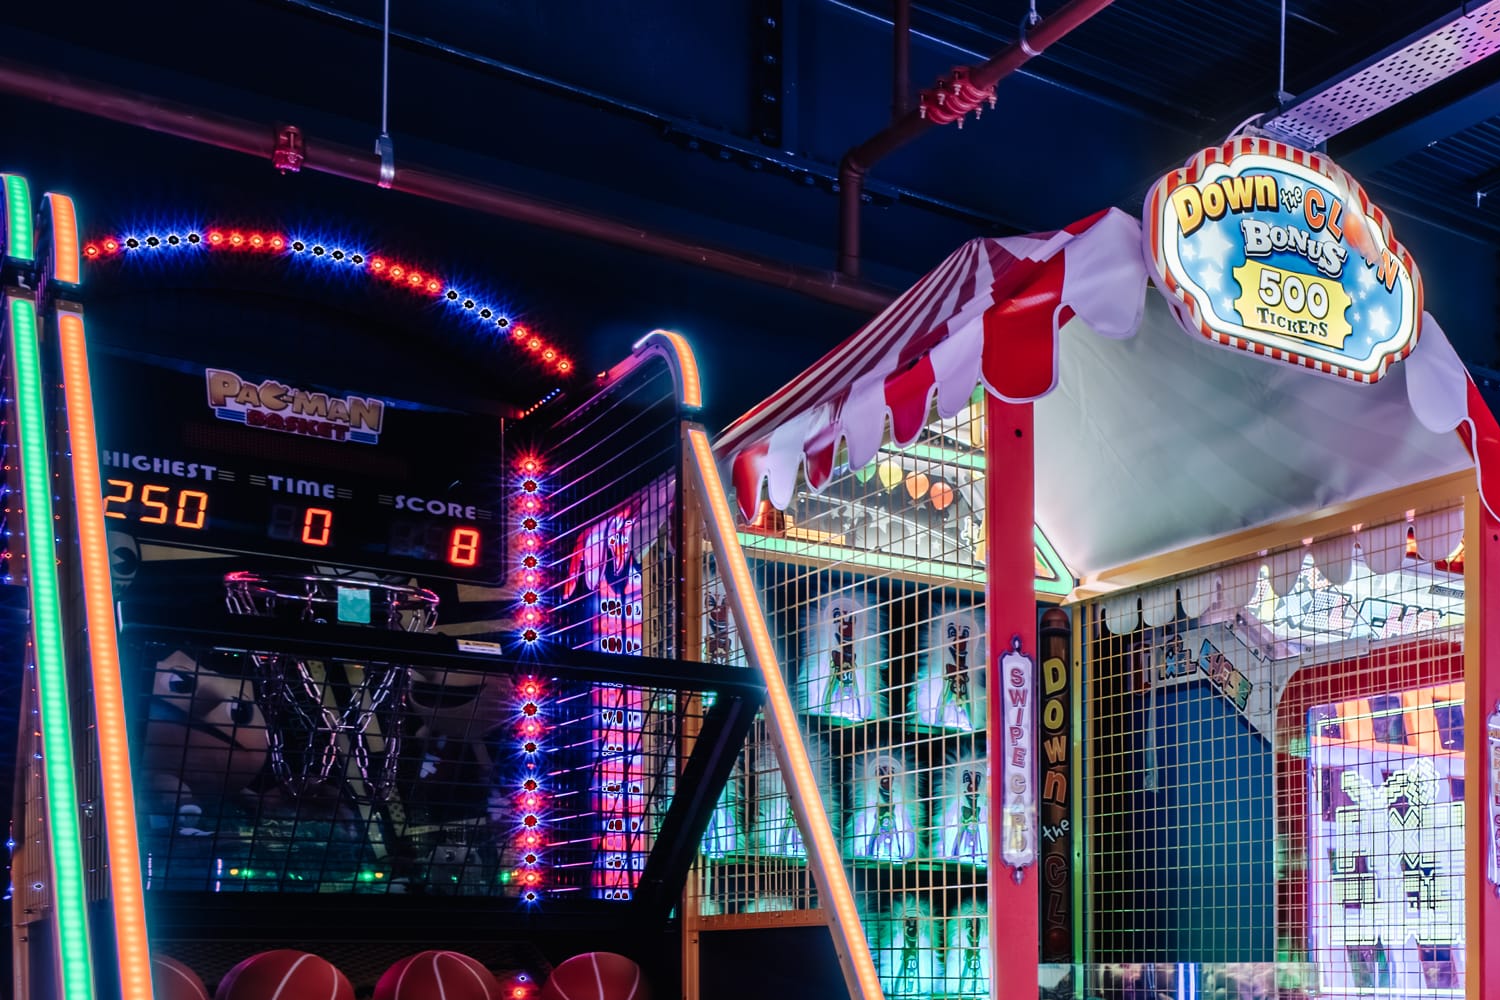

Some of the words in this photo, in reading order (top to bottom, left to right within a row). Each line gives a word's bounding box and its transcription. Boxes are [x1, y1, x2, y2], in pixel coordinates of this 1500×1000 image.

[1172, 175, 1278, 235] Down
[1280, 186, 1303, 213] the
[1241, 219, 1347, 277] BONUS
[1258, 268, 1330, 320] 500
[1257, 306, 1329, 338] TICKETS
[206, 368, 384, 433] PAC-MAN
[246, 408, 342, 442] BASKET
[102, 450, 217, 482] HIGHEST
[103, 479, 209, 530] 250
[266, 475, 335, 499] TIME
[302, 507, 333, 546] 0
[394, 495, 477, 520] SCORE
[450, 528, 480, 567] 8
[1008, 667, 1028, 769] SWIPE
[1042, 818, 1070, 843] the
